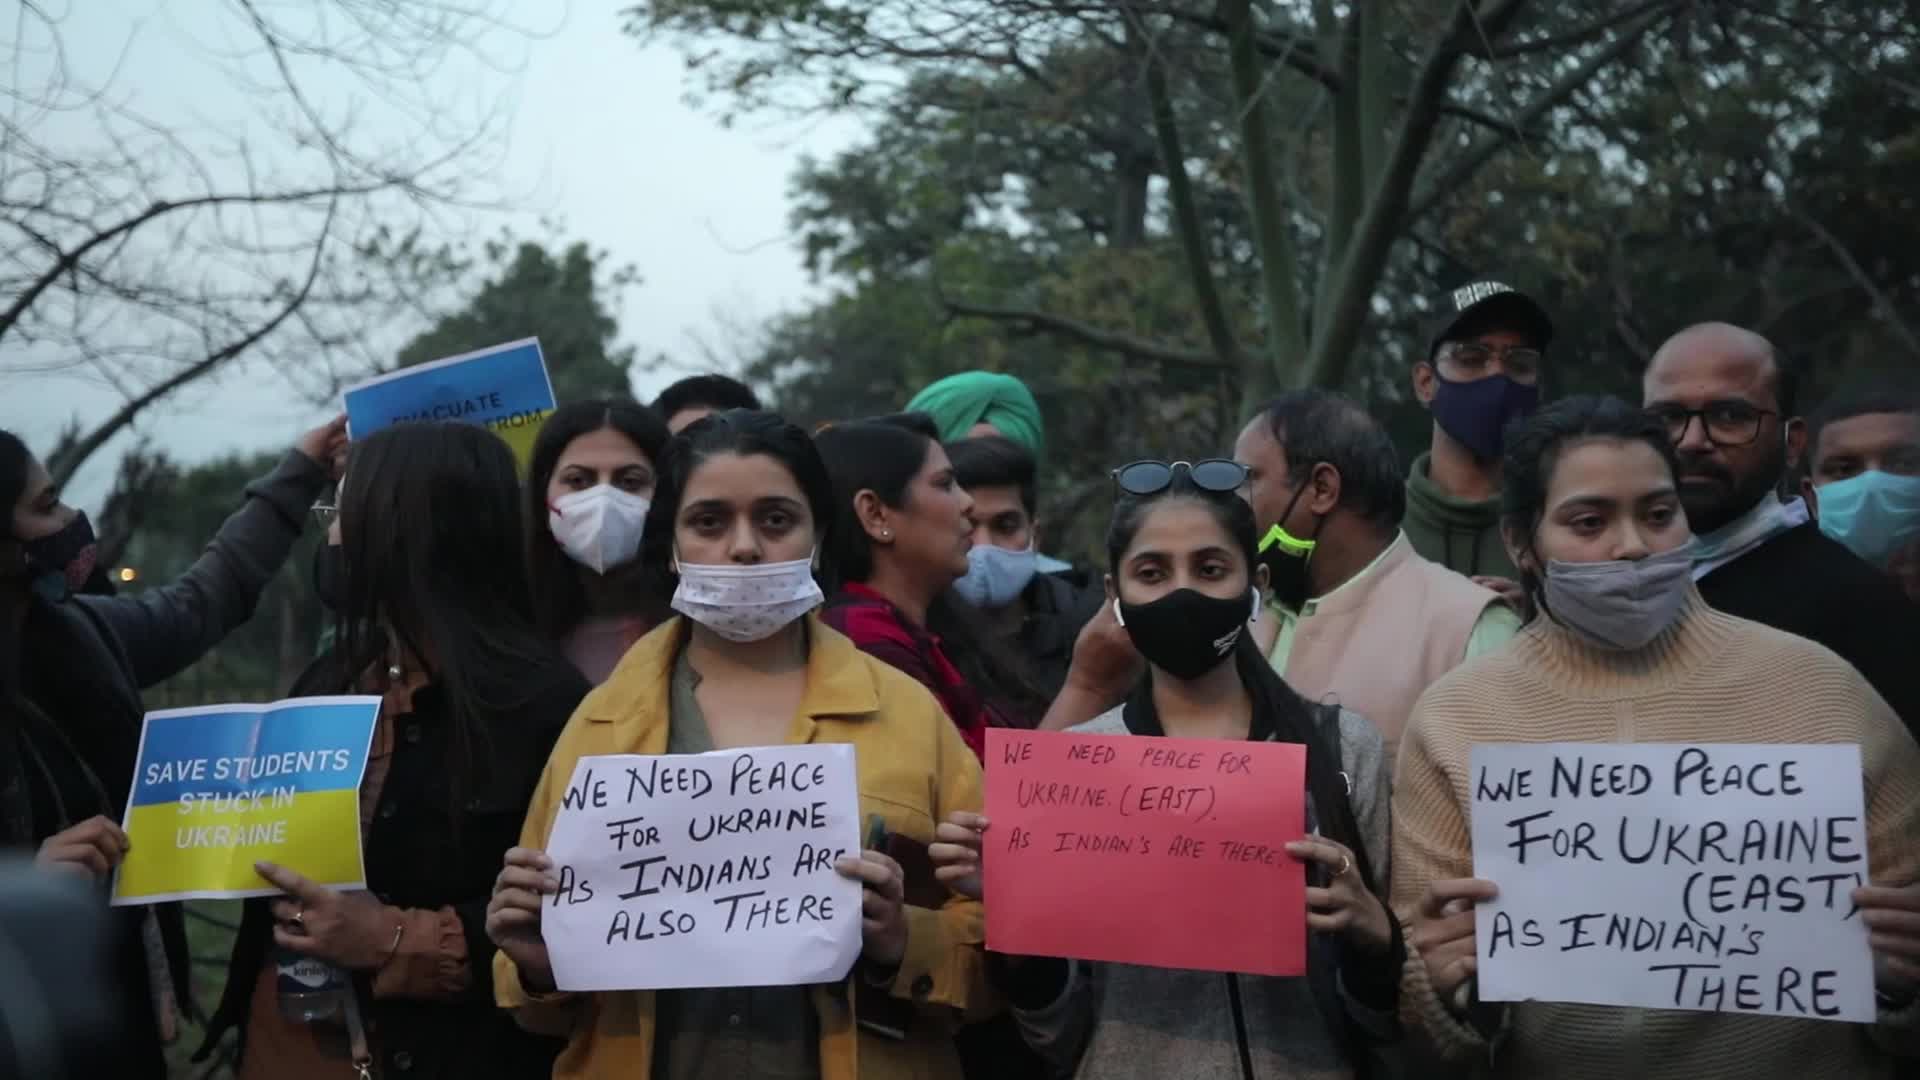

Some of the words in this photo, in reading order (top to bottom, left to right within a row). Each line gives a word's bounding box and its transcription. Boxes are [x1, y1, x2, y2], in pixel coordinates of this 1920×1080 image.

[145, 759, 208, 785] SAVE
[213, 749, 350, 782] STUDENTS
[563, 769, 608, 811] WE
[626, 760, 713, 803] NEED
[729, 754, 825, 796] PEACE
[1004, 743, 1033, 764] WE
[1067, 744, 1116, 765] NEED
[1139, 747, 1204, 770] PEACE
[1217, 752, 1252, 775] FOR
[1477, 766, 1533, 802] WE
[1550, 756, 1652, 798] NEED
[1674, 747, 1804, 797] PEACE
[177, 790, 267, 815] STUCK
[271, 786, 296, 809] IN
[175, 821, 288, 849] UKRAINE
[606, 817, 661, 851] FOR
[688, 802, 827, 842] UKRAINE
[1008, 827, 1032, 852] AS
[1054, 831, 1151, 855] INDIAN'S
[1167, 834, 1205, 858] ARE
[1506, 810, 1604, 865] FOR
[1618, 815, 1862, 866] UKRAINE
[553, 865, 593, 907] AS
[618, 855, 772, 900] INDIANS
[607, 910, 696, 945] ALSO
[713, 891, 835, 933] THERE
[1489, 911, 1545, 958] AS
[1560, 912, 1765, 959] INDIAN'S
[1648, 963, 1841, 1016] THERE
